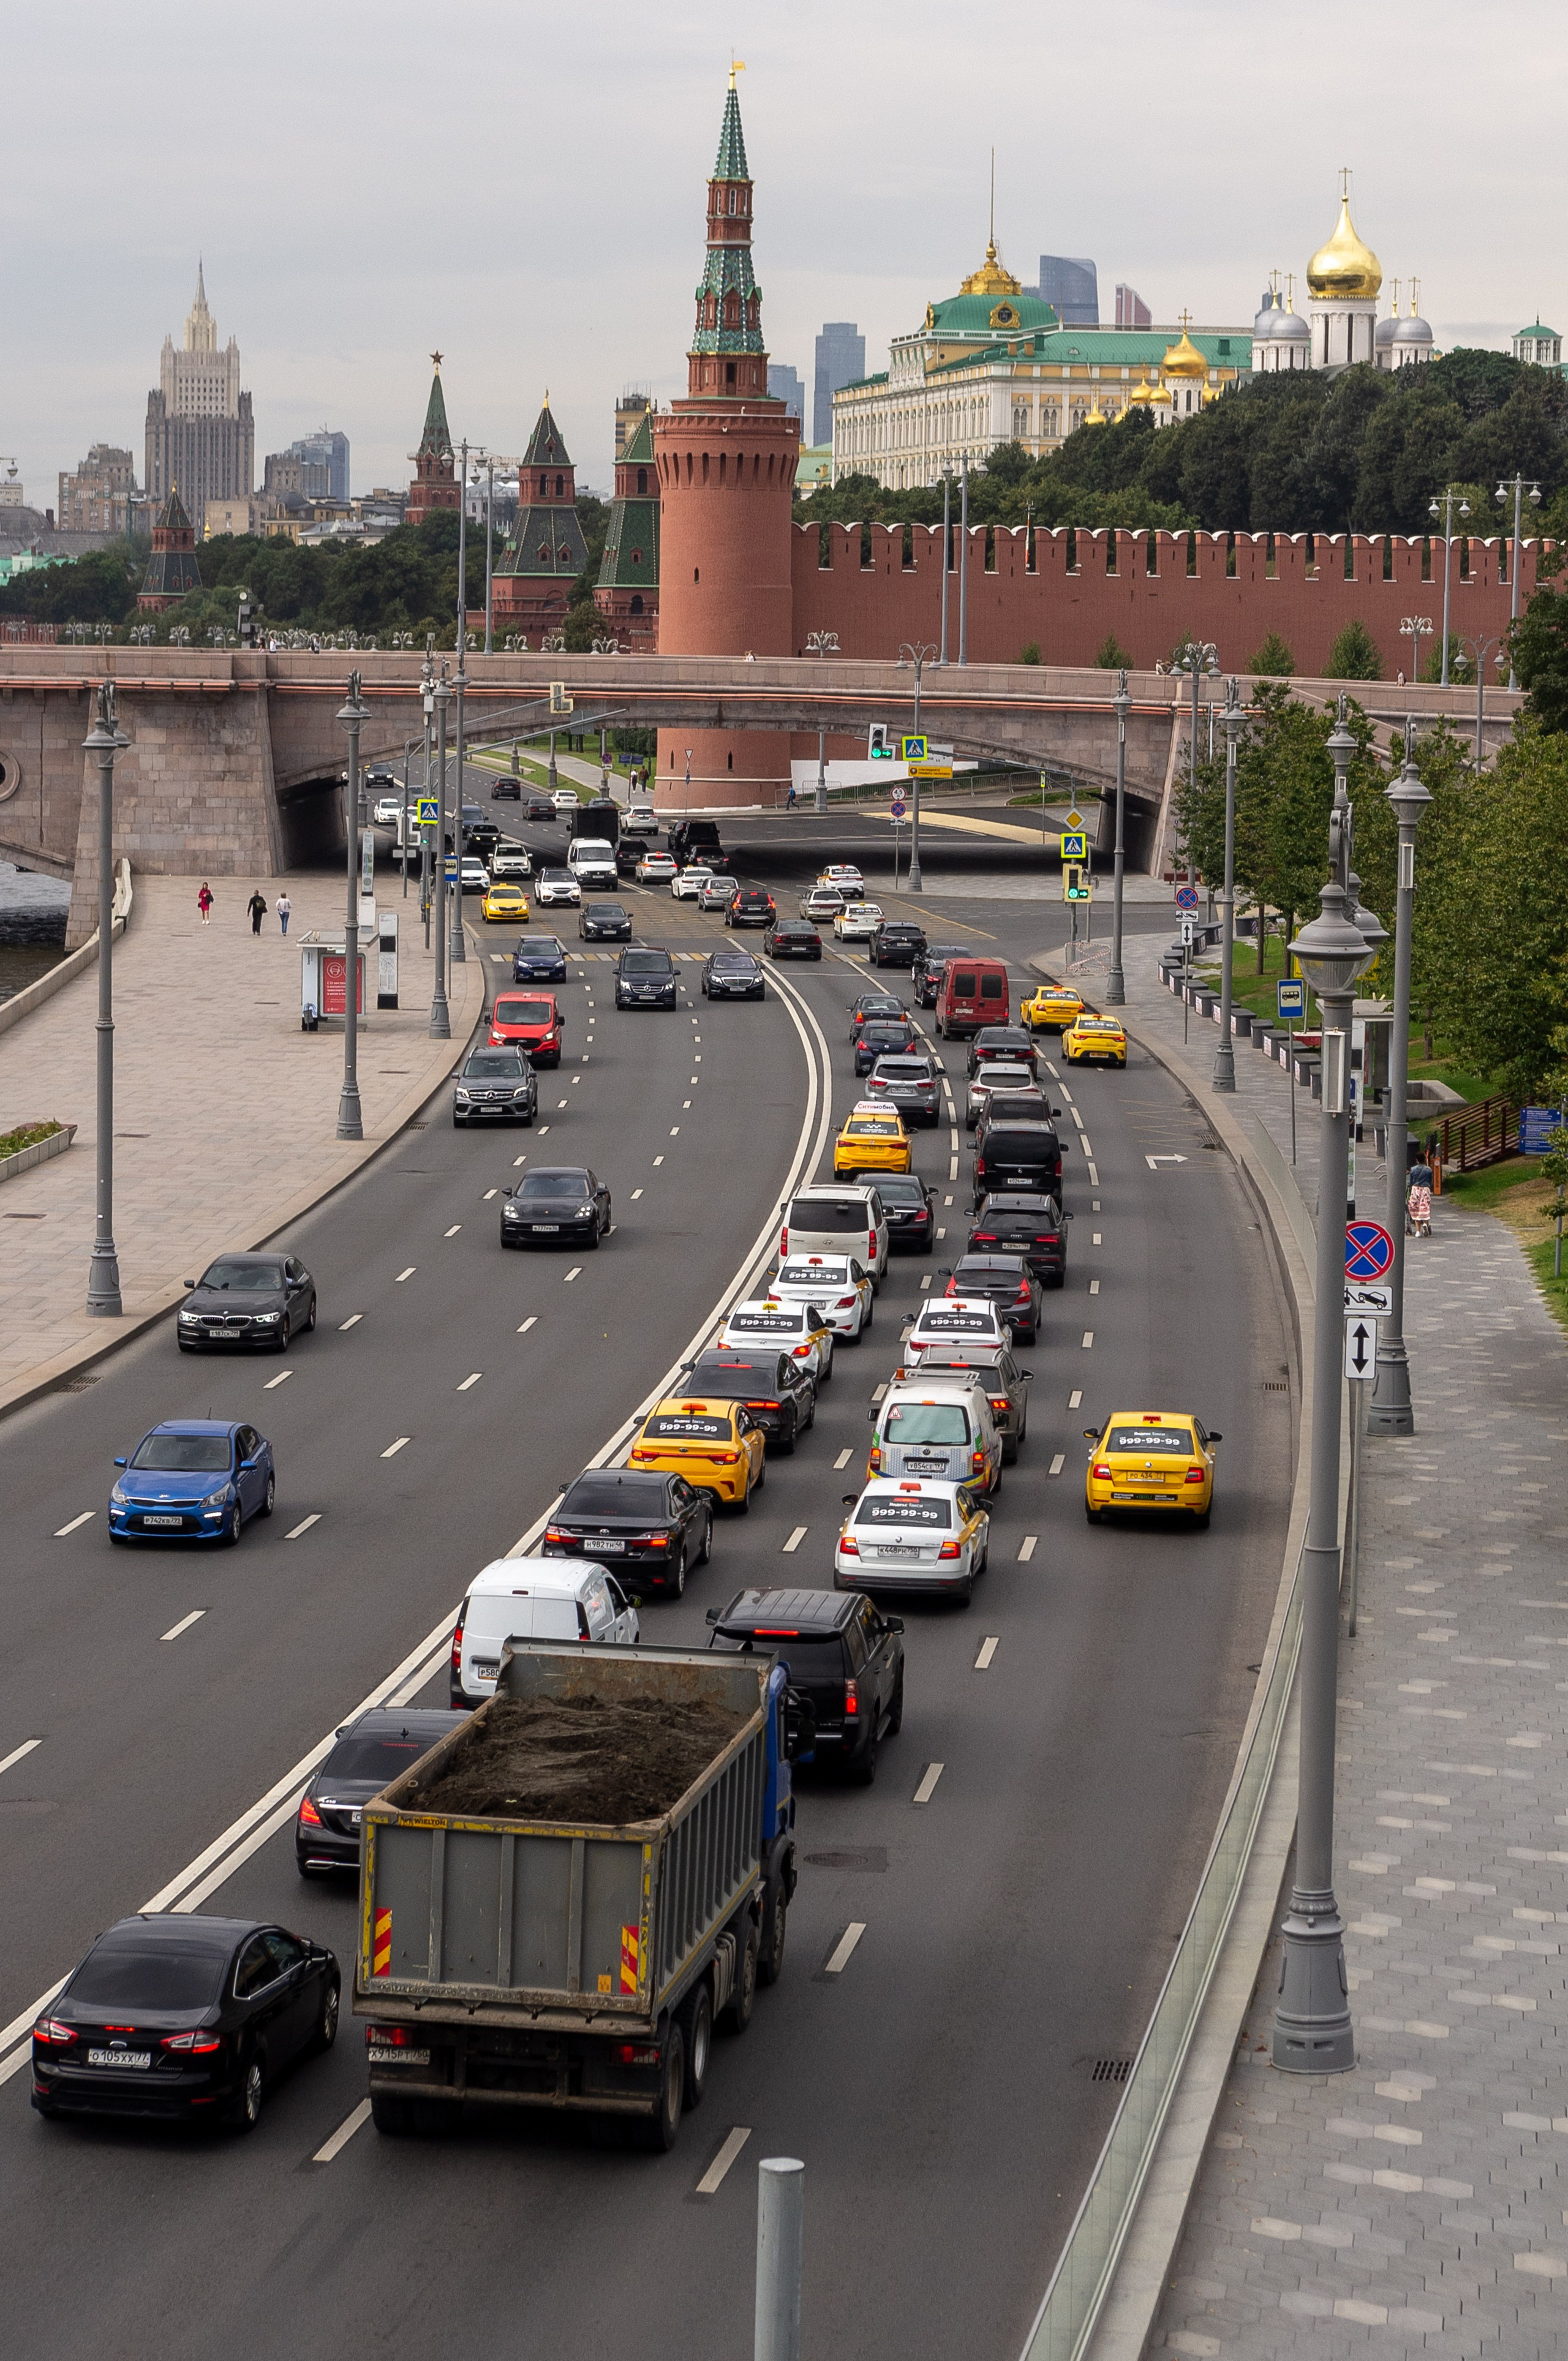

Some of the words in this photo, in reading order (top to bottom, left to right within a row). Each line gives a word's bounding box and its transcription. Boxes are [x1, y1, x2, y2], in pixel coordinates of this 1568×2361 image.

[659, 1423, 718, 1432] 999-99-99
[872, 1508, 938, 1519] 999-99-99
[414, 1817, 446, 1826] WIELTON
[92, 2050, 134, 2063] О105ХХ
[371, 2048, 410, 2060] Х915РТ
